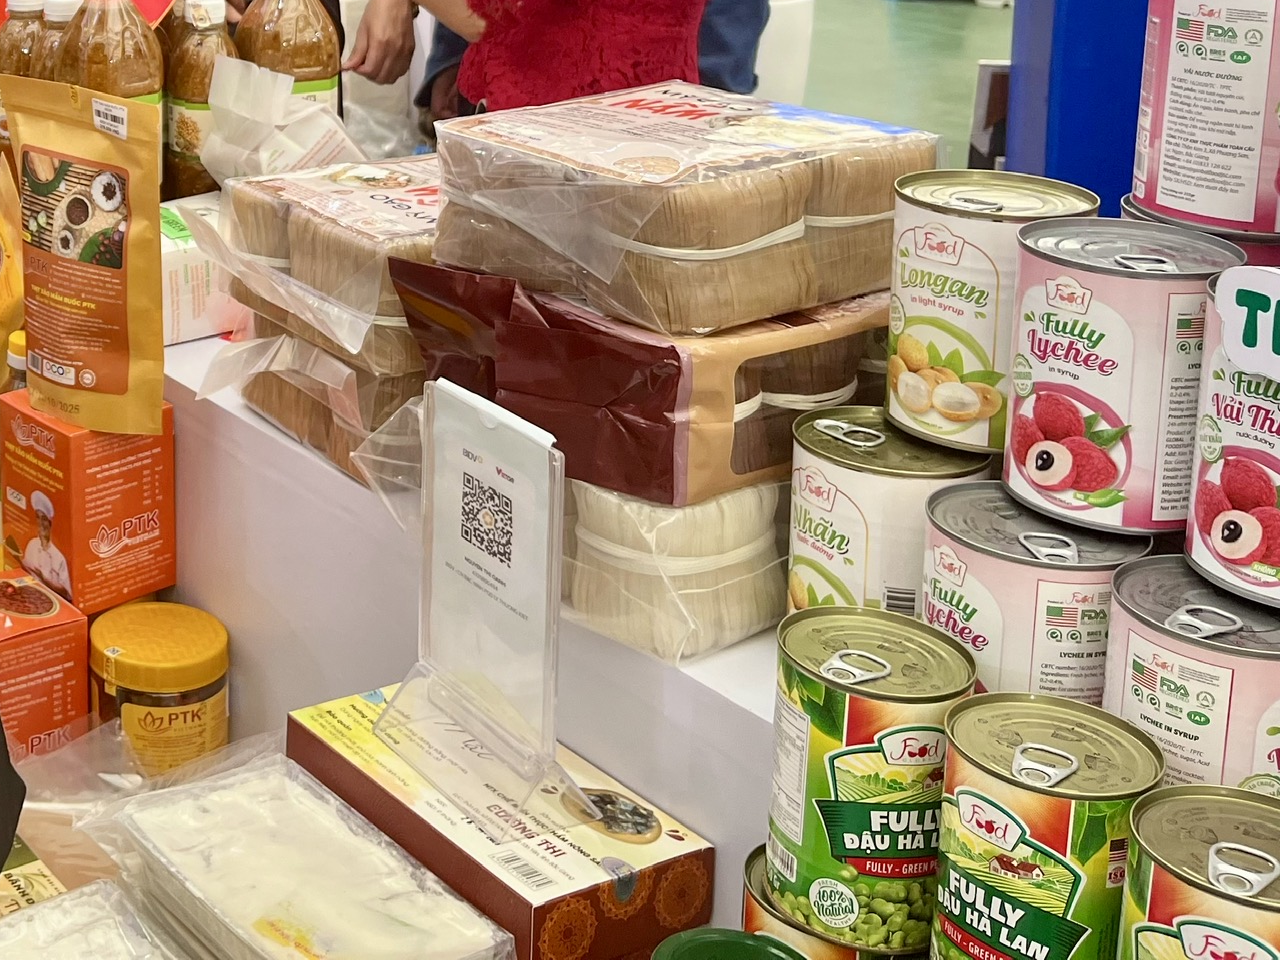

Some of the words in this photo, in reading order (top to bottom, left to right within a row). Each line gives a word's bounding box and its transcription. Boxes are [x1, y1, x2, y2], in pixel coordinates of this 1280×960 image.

[1207, 24, 1238, 40] FDA
[900, 262, 989, 308] Longan
[911, 294, 918, 302] in
[918, 296, 936, 307] light
[938, 302, 965, 316] syrup
[1039, 312, 1106, 352] Fully
[1027, 329, 1118, 376] Lychee
[1057, 367, 1080, 380] syrup
[1230, 371, 1280, 404] Full
[1212, 393, 1245, 426] Vải
[122, 509, 159, 539] PTK
[793, 500, 850, 554] Nhãn
[931, 578, 977, 624] Fully
[1081, 609, 1108, 620] FDA
[1160, 676, 1190, 698] FDA
[169, 709, 202, 726] PTK
[1139, 713, 1162, 729] LYCHEE
[1164, 724, 1172, 733] IN
[1174, 729, 1200, 741] SYRUP
[1191, 714, 1206, 722] IAF
[29, 724, 71, 754] PTK
[843, 830, 890, 854] ĐẬU
[898, 830, 924, 850] HÀ
[866, 861, 894, 874] FULLY
[902, 862, 928, 875] GREEN
[817, 880, 838, 888] FRESH
[813, 897, 856, 918] Natural
[818, 889, 847, 904] 100%
[949, 868, 1026, 929] FULLY
[824, 916, 853, 927] HEALTHY
[937, 884, 961, 916] ĐẬU
[966, 906, 992, 937] HÀ
[999, 927, 1050, 960] LAN
[944, 921, 963, 943] FULLY
